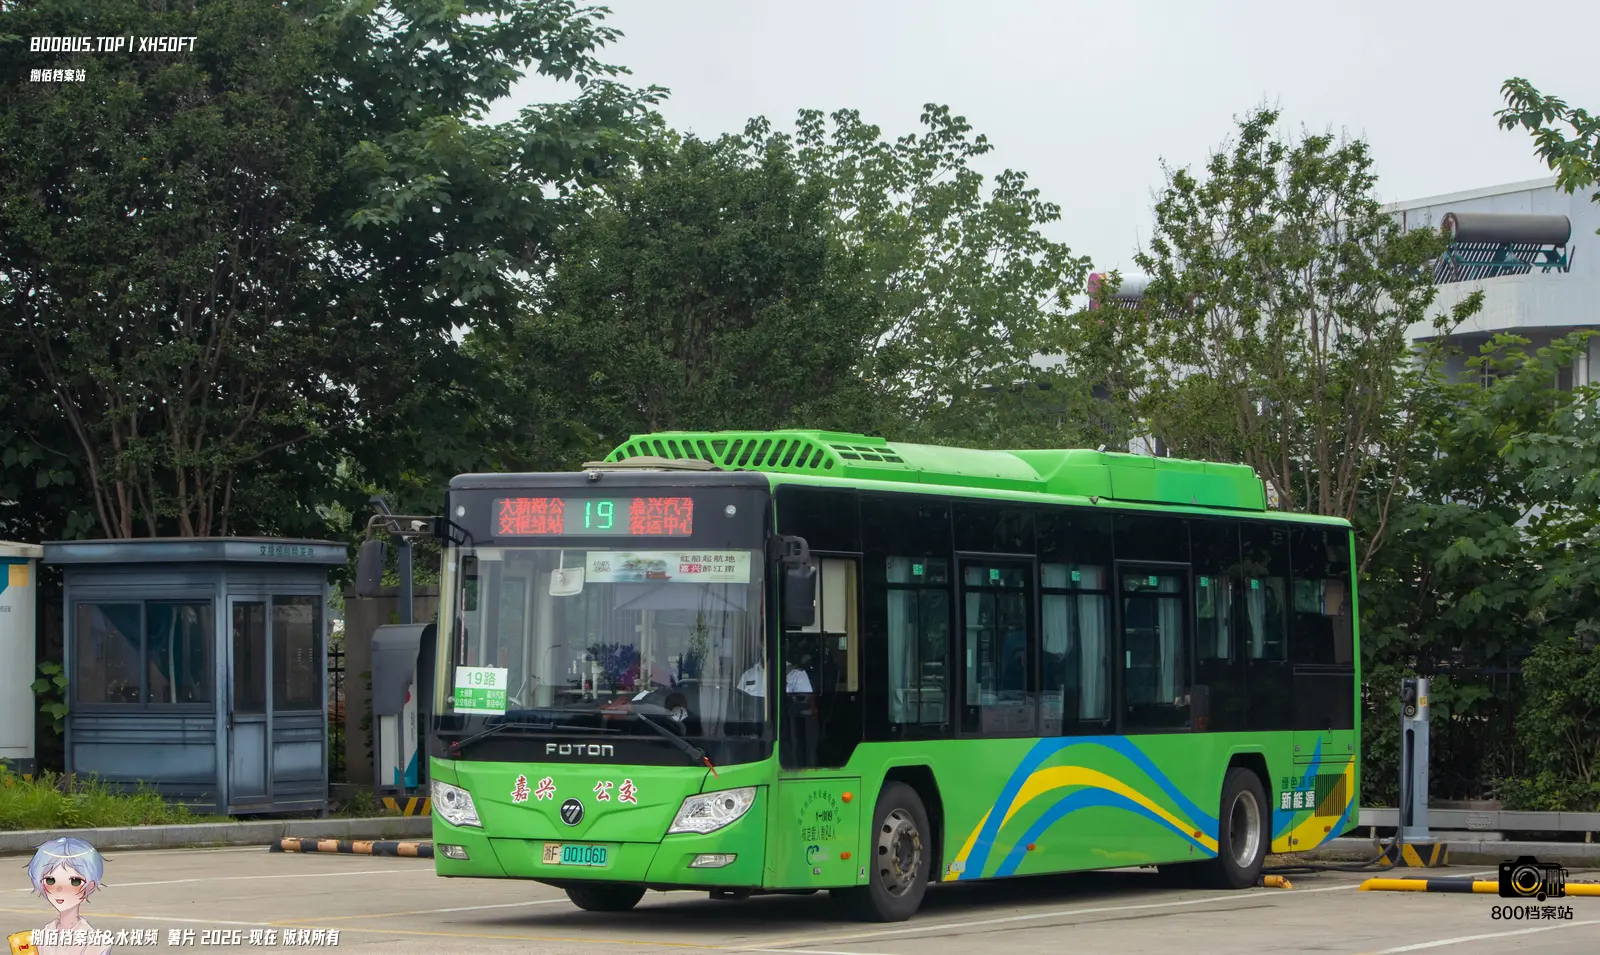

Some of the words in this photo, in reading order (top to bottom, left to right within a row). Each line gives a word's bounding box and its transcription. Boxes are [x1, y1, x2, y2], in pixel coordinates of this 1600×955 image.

[499, 498, 565, 516] 大新路公
[583, 500, 615, 529] 19
[629, 497, 694, 517] 嘉兴汽车
[499, 516, 564, 535] 交枢纽站
[629, 516, 693, 535] 客运中心
[680, 554, 736, 563] 红船起航地
[679, 563, 736, 574] 嘉兴醉江南
[466, 671, 496, 687] 19路
[545, 743, 614, 757] FOTON
[510, 774, 557, 803] 嘉兴
[592, 778, 638, 805] 公交
[1281, 791, 1315, 810] 新能源
